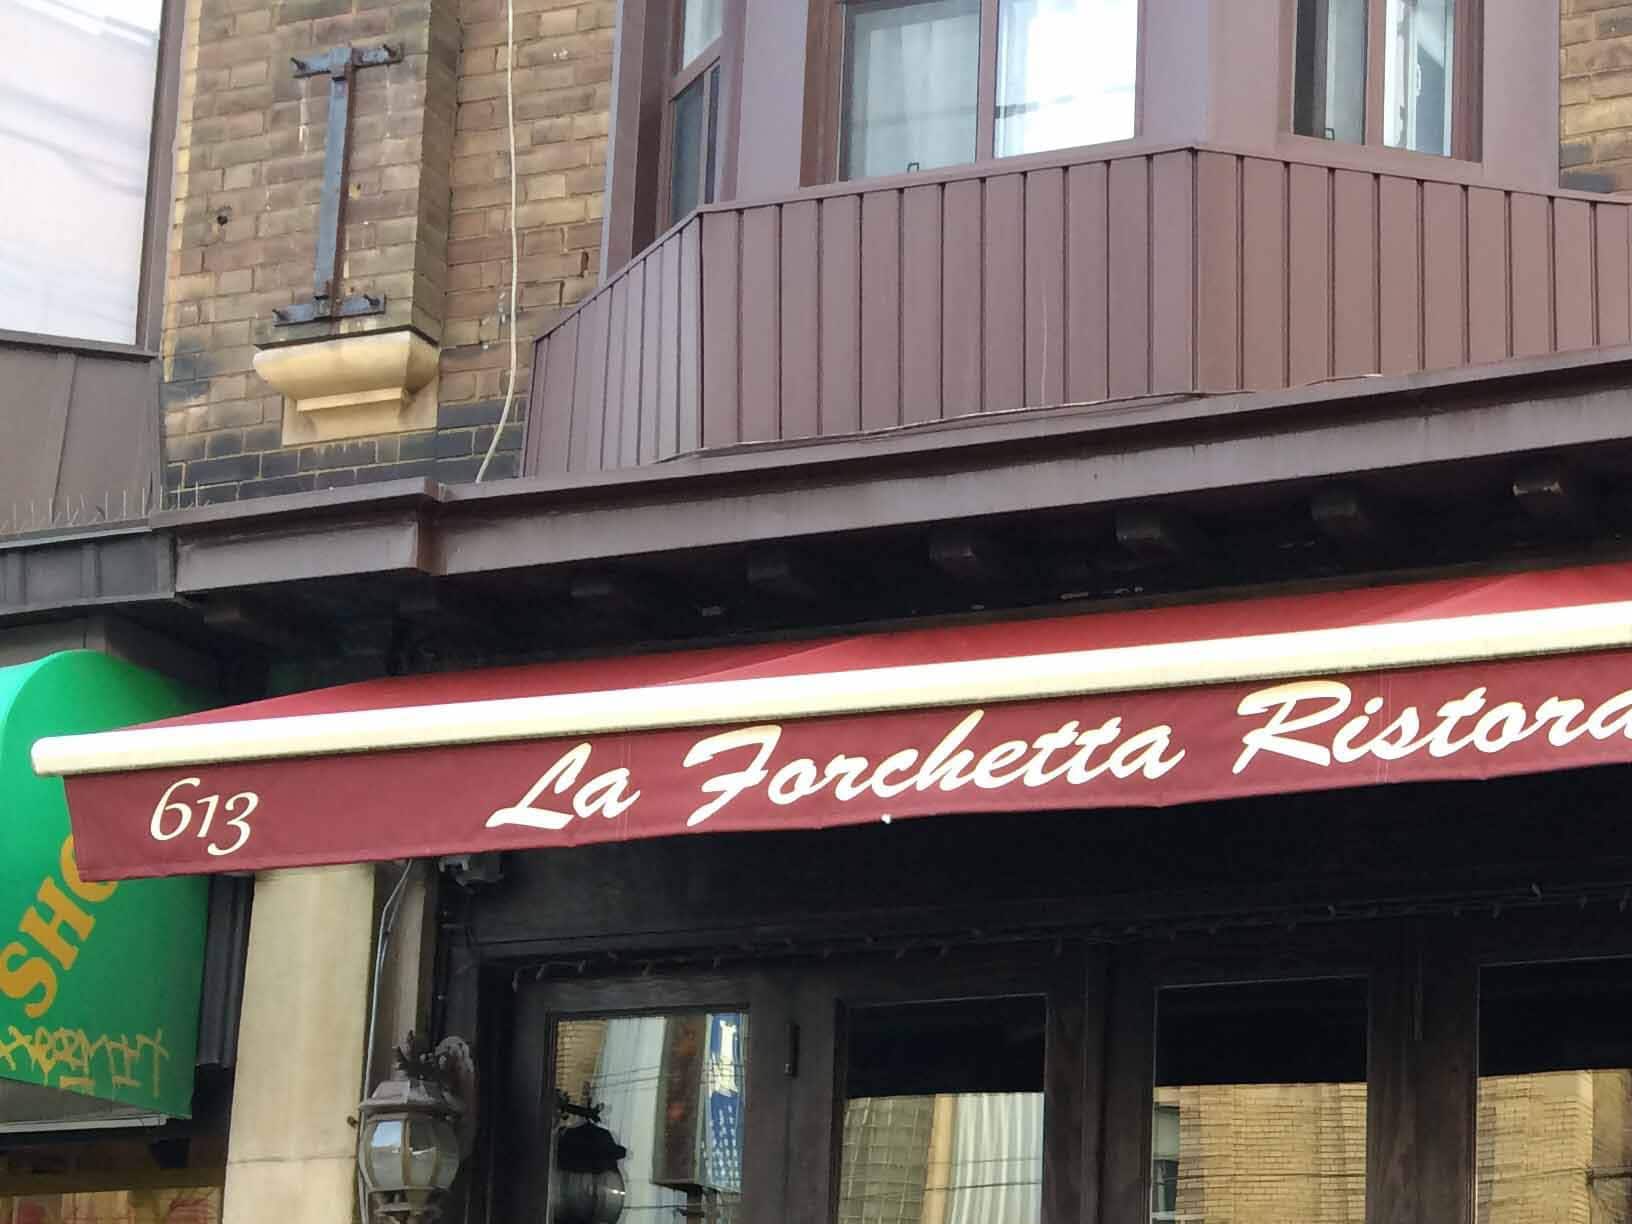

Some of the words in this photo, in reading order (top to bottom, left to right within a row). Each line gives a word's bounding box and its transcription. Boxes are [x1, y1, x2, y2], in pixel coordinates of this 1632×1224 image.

[149, 776, 260, 856] 613
[485, 742, 640, 831] La
[682, 709, 1186, 828] Forchetta
